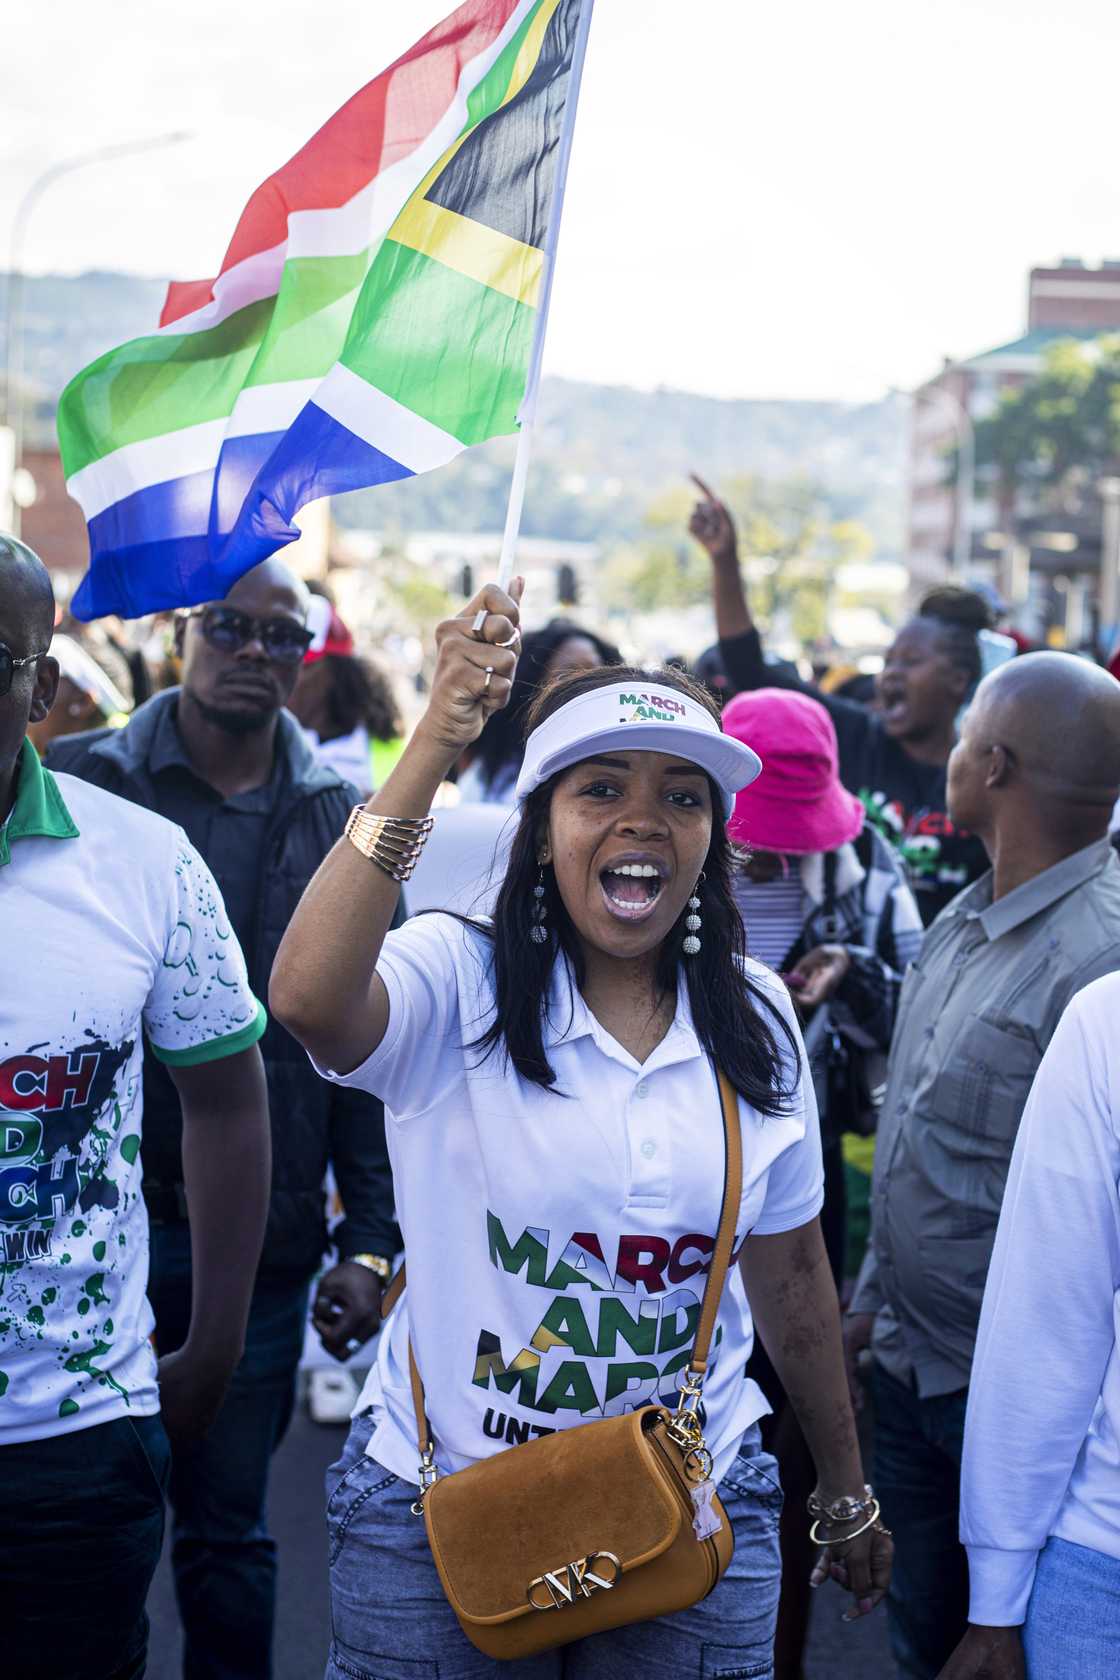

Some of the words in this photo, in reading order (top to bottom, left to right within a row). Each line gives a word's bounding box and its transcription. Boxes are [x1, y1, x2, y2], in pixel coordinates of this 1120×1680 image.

[619, 693, 686, 716] MARCH
[630, 705, 675, 721] AND
[486, 1207, 746, 1294] MARC
[483, 1407, 566, 1445] UNT
